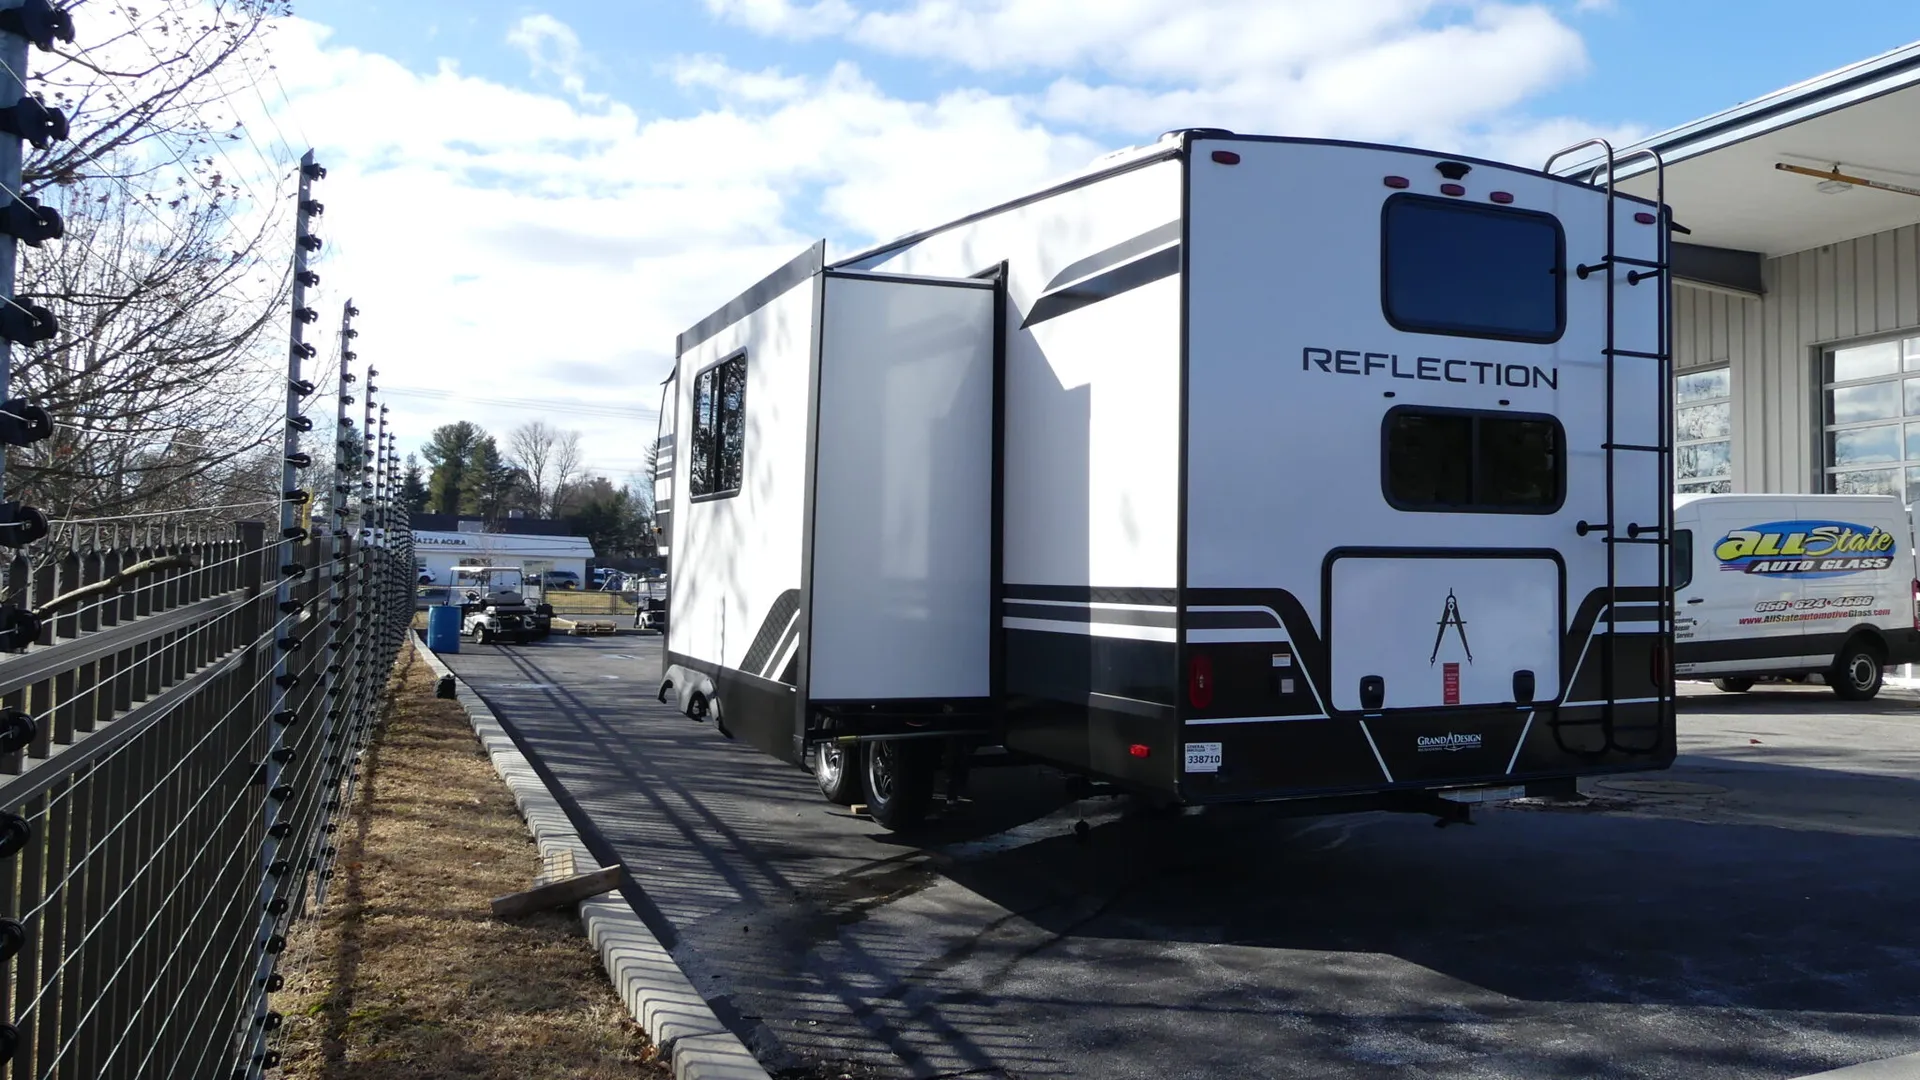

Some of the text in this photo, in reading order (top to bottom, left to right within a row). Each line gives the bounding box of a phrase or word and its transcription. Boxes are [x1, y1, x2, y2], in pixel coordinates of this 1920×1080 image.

[1303, 347, 1557, 389] REFLECTION
[413, 536, 438, 544] IAZZA
[1752, 557, 1888, 573] AUTO GLASS
[1417, 734, 1482, 746] GRAND DESIGN
[1188, 755, 1220, 764] 338710
